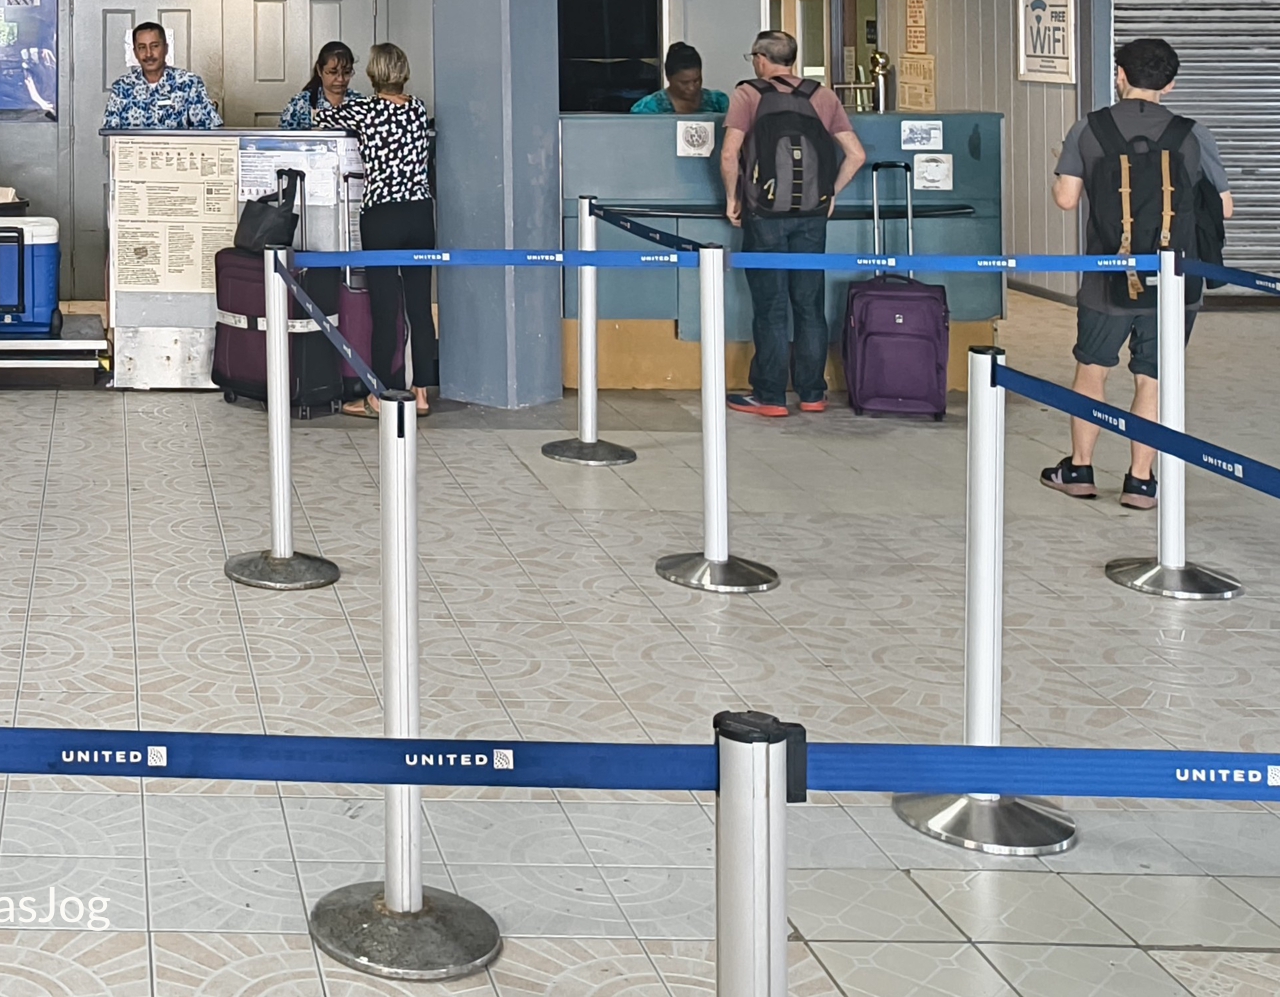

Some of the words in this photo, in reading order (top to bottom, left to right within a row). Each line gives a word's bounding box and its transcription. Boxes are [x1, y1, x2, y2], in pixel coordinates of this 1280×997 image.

[1051, 11, 1066, 23] FREE
[1030, 26, 1066, 55] WiFi
[856, 258, 886, 266] UNITED
[977, 259, 1007, 267] UNITED
[1097, 259, 1127, 267] UNITED
[1092, 409, 1118, 426] UNITED
[1202, 454, 1233, 472] UNITED
[61, 750, 143, 764] UNITED
[405, 753, 488, 766] UNITED
[1175, 768, 1262, 783] UNITED
